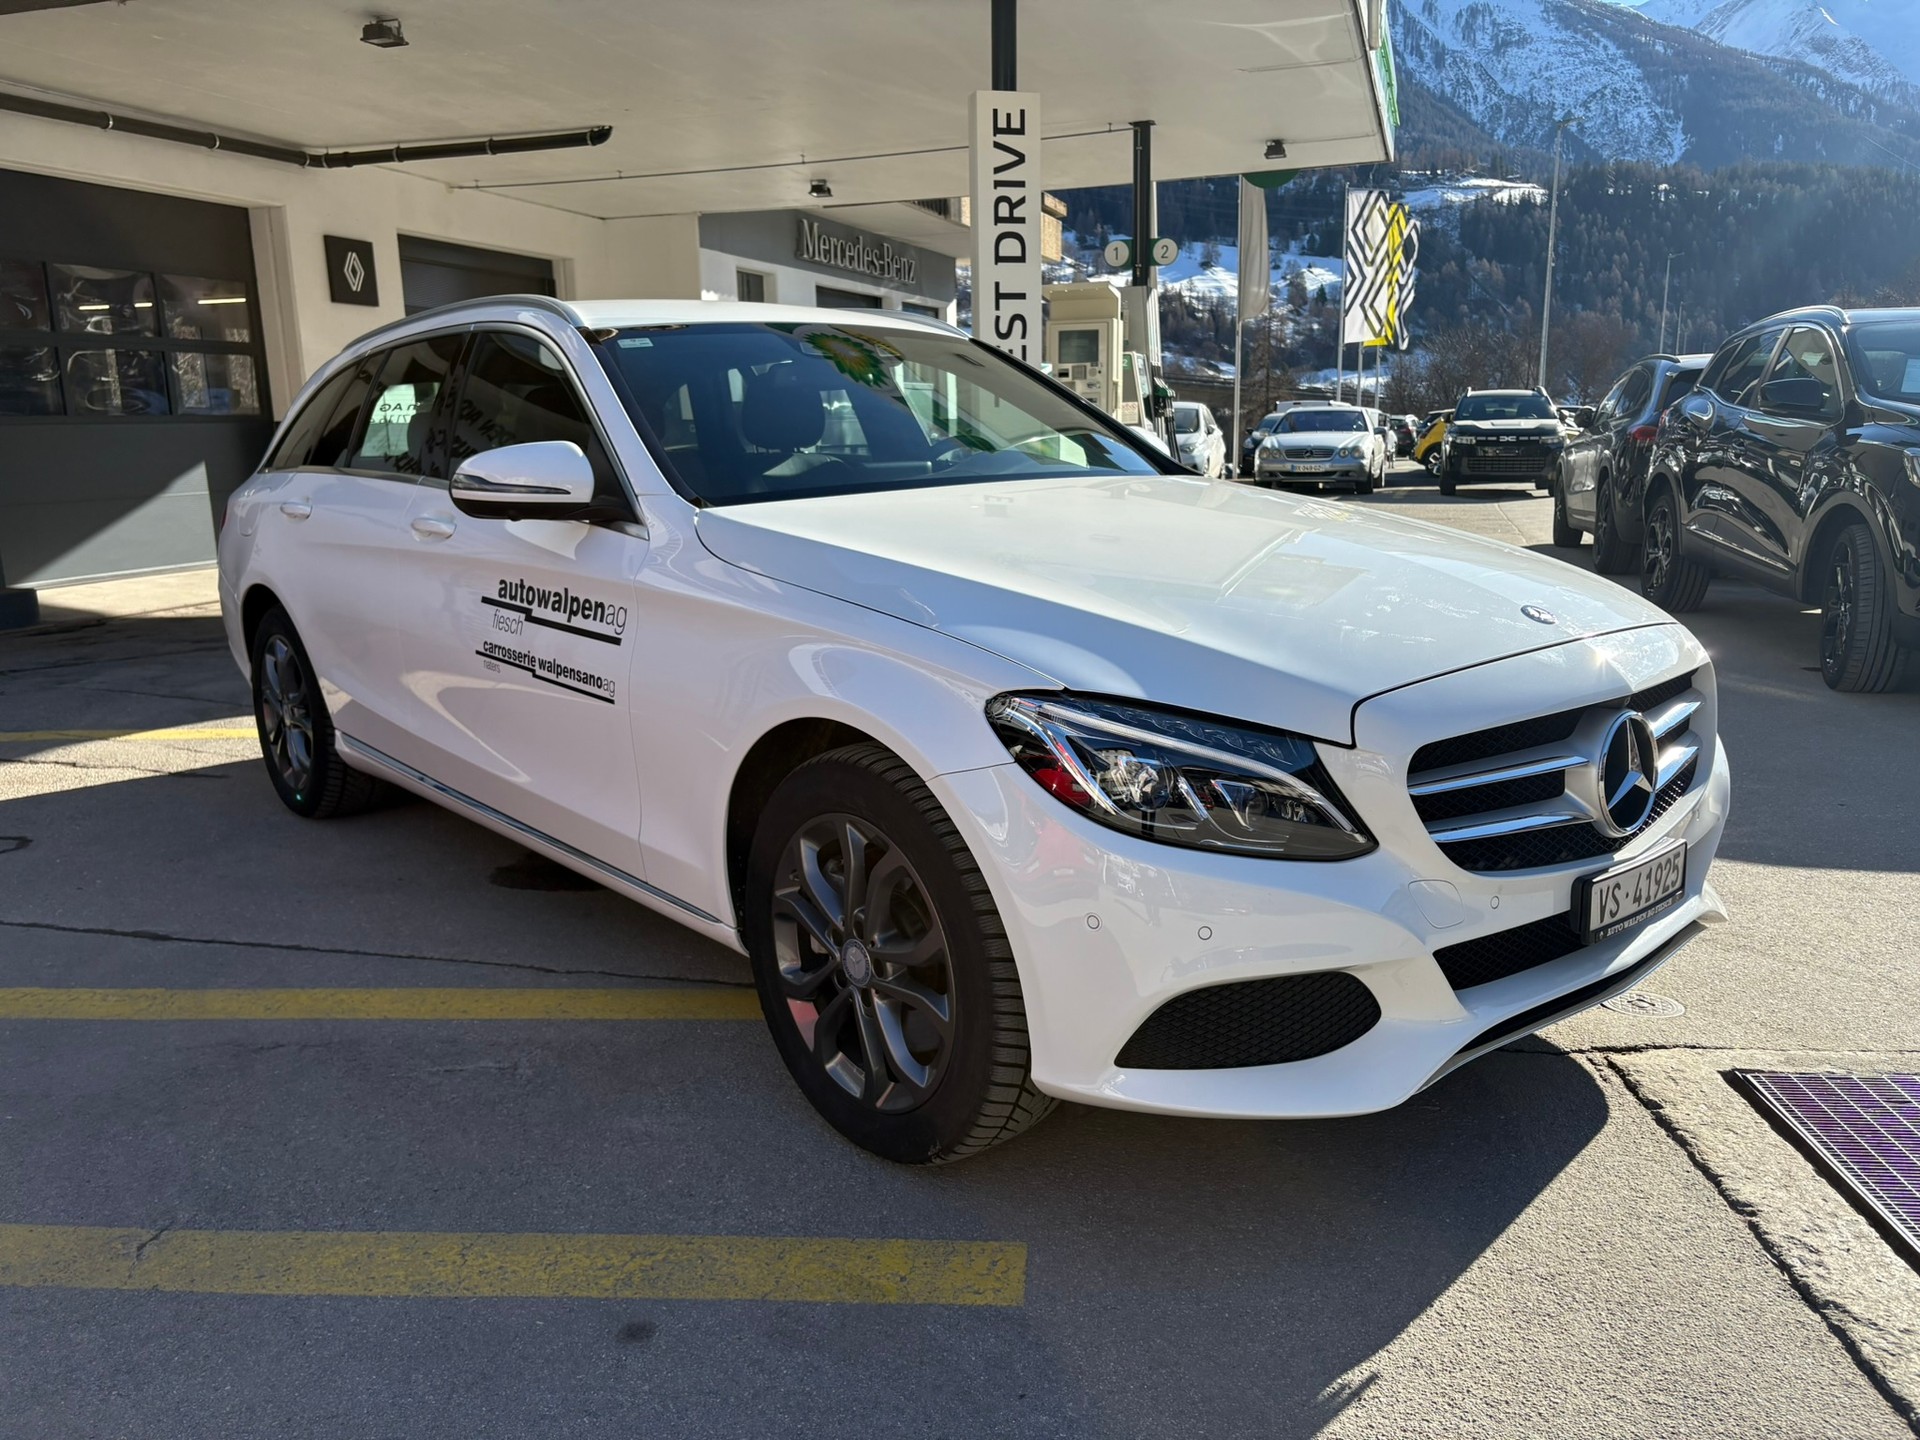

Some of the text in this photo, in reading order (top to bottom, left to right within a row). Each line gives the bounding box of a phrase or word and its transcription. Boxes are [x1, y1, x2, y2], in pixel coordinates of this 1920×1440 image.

[992, 108, 1027, 265] DRIVE
[800, 218, 916, 284] Mercedes-Benz
[1113, 247, 1119, 260] 1
[1161, 244, 1169, 259] 2
[498, 578, 628, 635] autowalpenag
[492, 608, 524, 636] fiesch
[483, 640, 536, 668] carrosserie
[483, 660, 501, 674] naters
[538, 658, 616, 697] walpensanoag
[1607, 923, 1624, 937] AUTO
[1624, 912, 1648, 929] WALPEN
